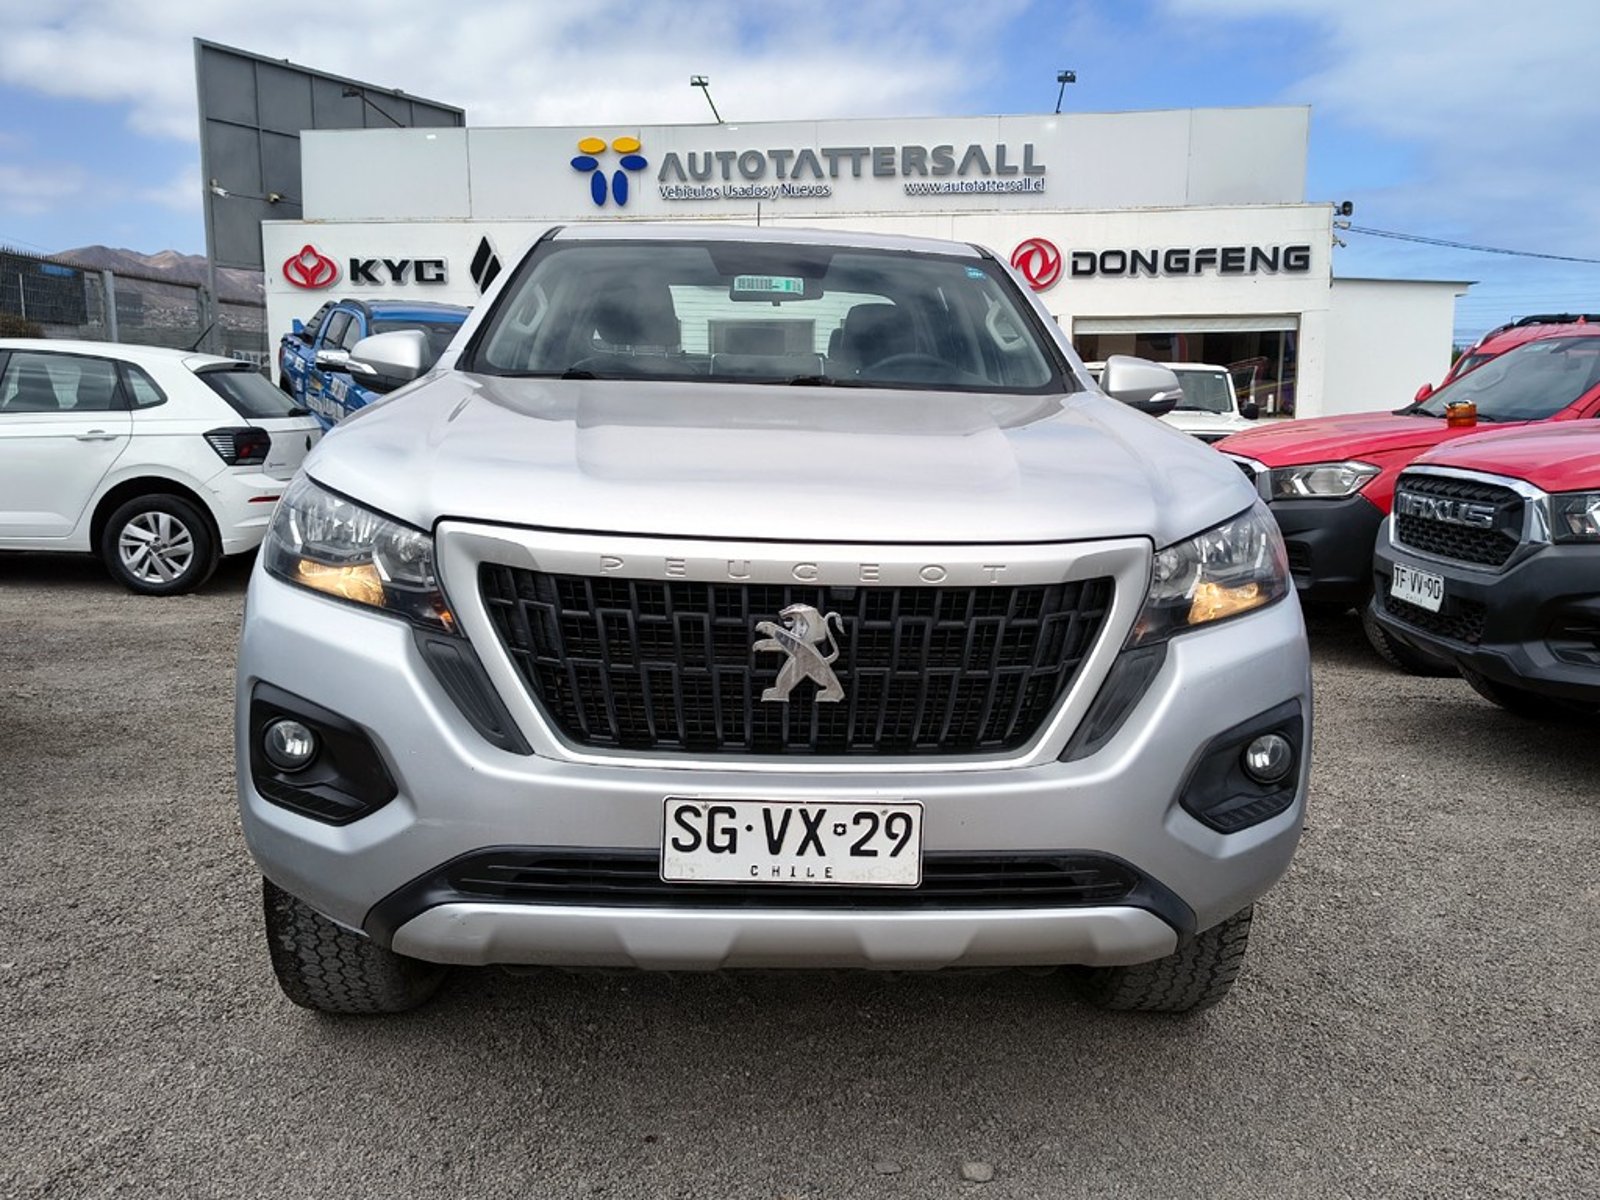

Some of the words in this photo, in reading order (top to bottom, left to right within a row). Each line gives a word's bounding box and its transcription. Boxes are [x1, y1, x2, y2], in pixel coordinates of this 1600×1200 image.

[657, 144, 1046, 182] AUTOTATTERSALL
[722, 183, 769, 197] Usados
[780, 182, 830, 197] Nuevos
[904, 177, 1046, 195] www.autotattersall.cl
[349, 257, 446, 284] KYC
[1071, 245, 1311, 276] DONGFENG
[599, 554, 1008, 584] PEUGEOT
[749, 864, 834, 879] CHILE
